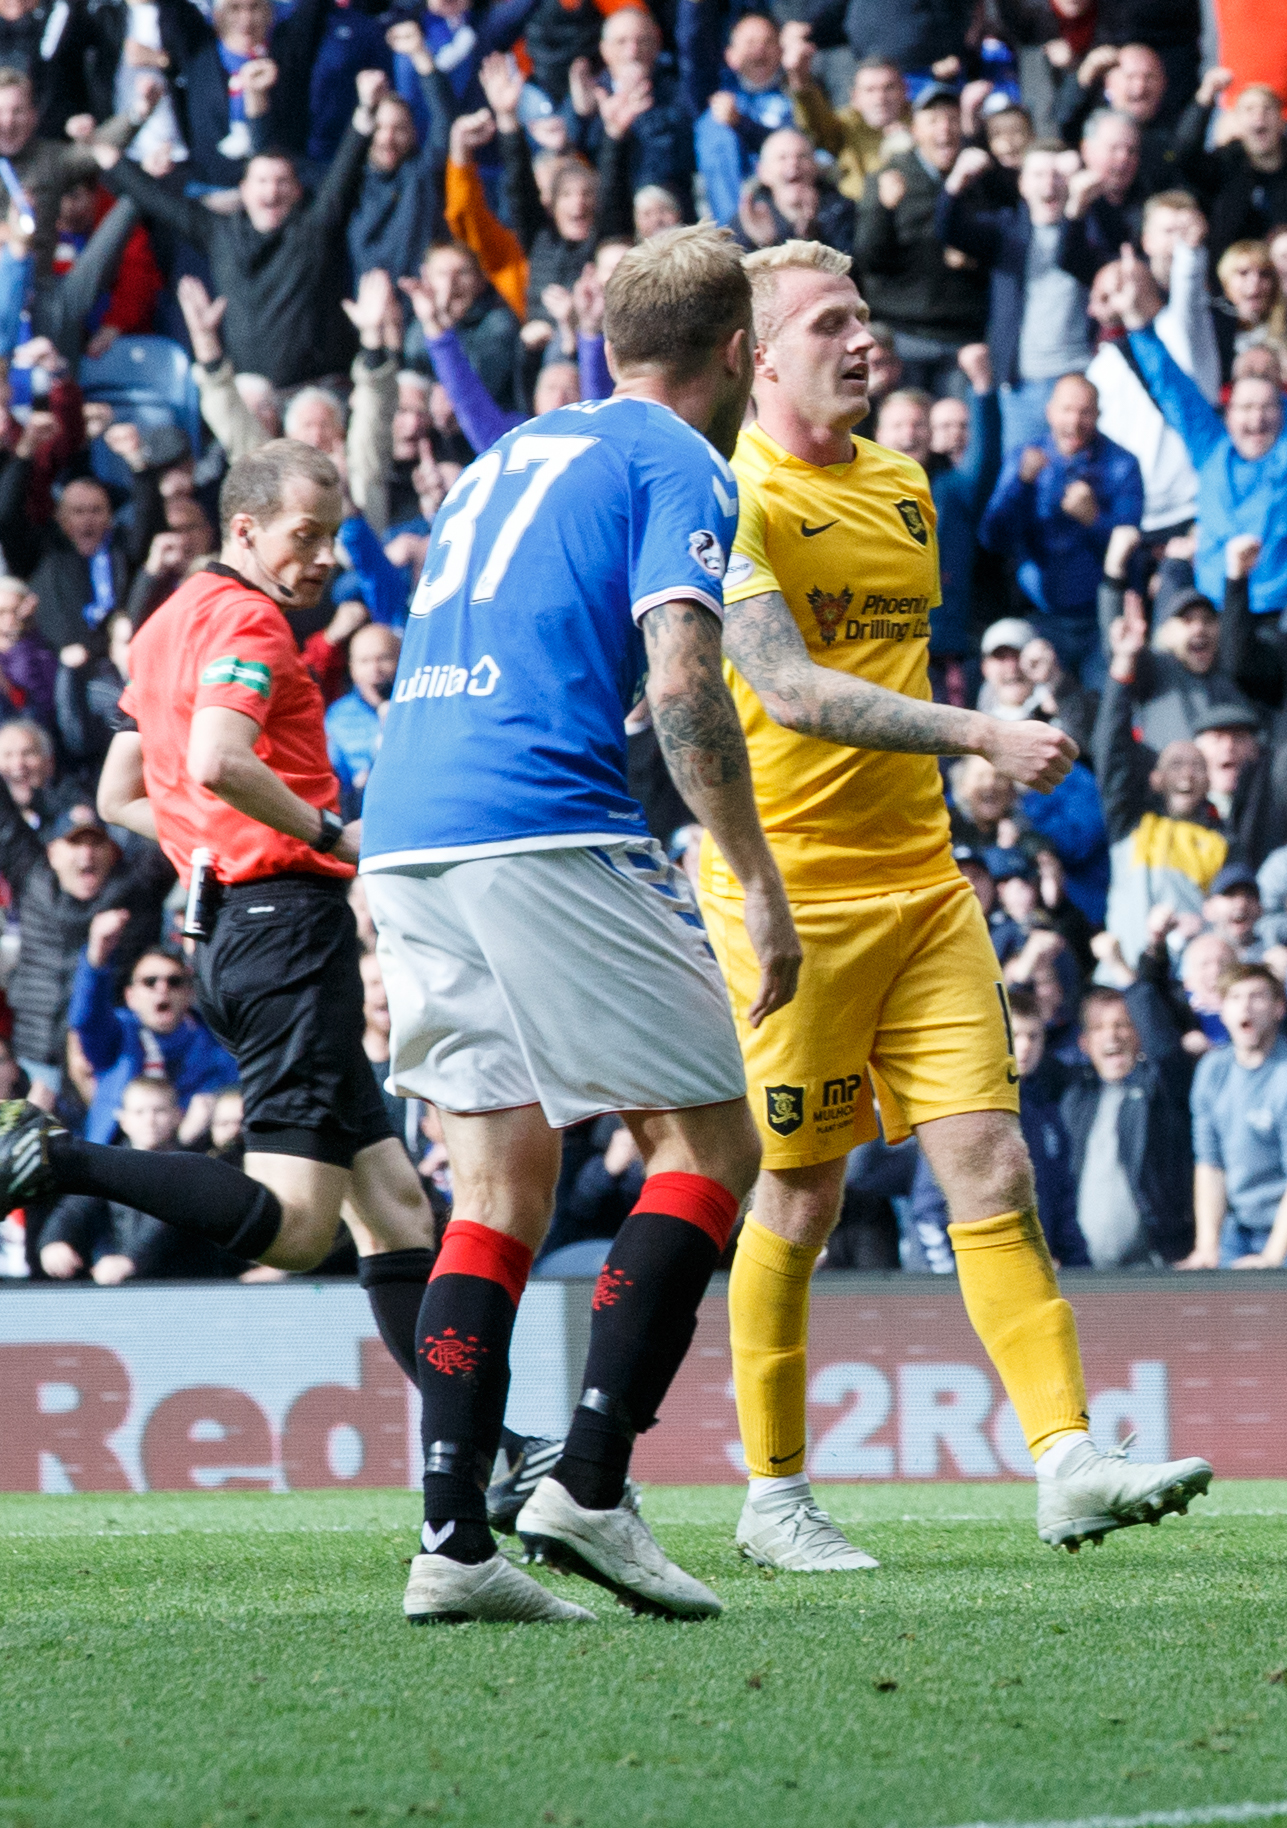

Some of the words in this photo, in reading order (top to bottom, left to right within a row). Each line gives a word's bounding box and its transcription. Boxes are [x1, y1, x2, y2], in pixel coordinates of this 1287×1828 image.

[409, 434, 602, 618] 37
[845, 620, 911, 642] Drilling
[723, 1360, 1170, 1478] 2Rd
